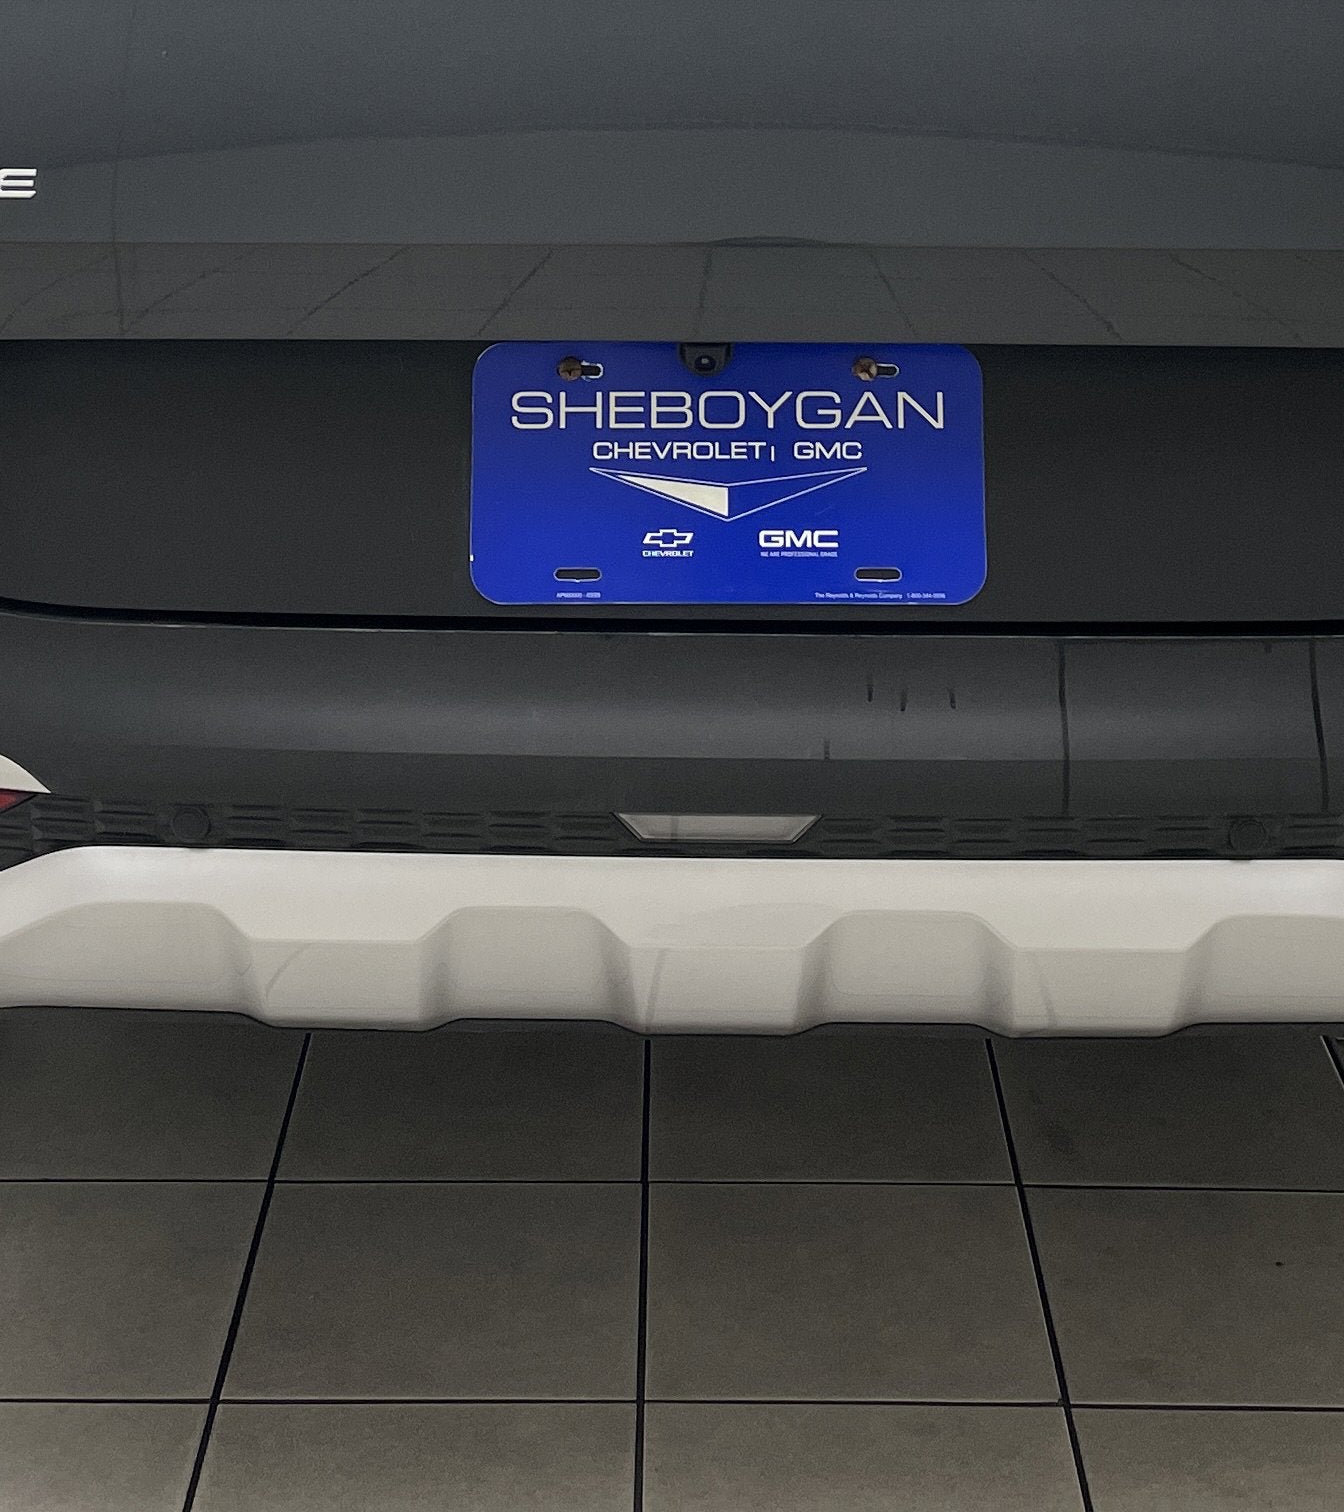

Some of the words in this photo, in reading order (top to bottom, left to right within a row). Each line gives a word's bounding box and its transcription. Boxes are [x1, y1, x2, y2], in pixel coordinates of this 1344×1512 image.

[511, 390, 945, 430] SHEBOYGAN
[592, 441, 767, 461] CHEVROLET
[793, 441, 863, 461] GMC
[758, 529, 839, 548] GMC
